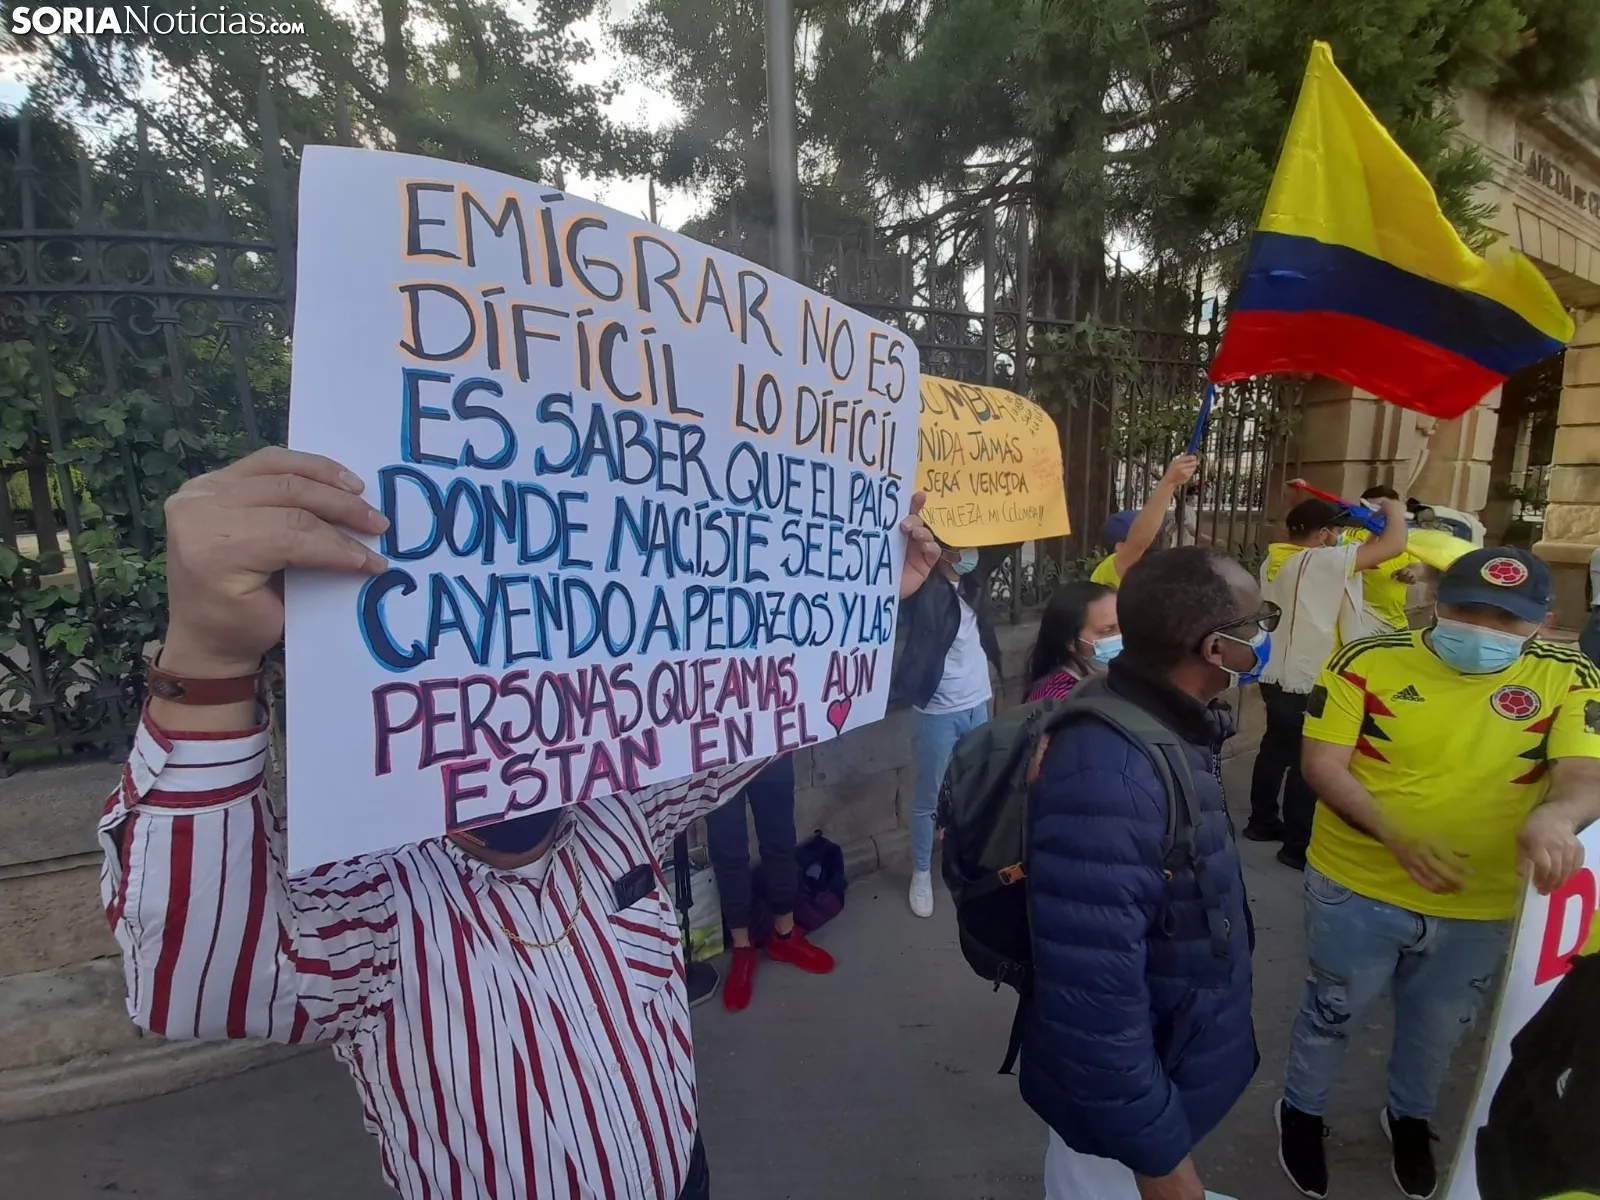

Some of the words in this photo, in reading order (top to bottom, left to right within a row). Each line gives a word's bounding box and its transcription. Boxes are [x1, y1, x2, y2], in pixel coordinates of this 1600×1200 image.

[736, 363, 781, 435] LO
[802, 299, 854, 381] NO
[869, 331, 905, 403] ES
[401, 367, 517, 470] ES
[535, 391, 723, 502] SABER
[726, 441, 804, 518] QUE
[811, 460, 845, 523] EL
[848, 471, 900, 531] PAÍS
[917, 421, 965, 466] NIDA
[967, 431, 1023, 464] JAMÁS
[923, 469, 960, 498] SERÁ
[969, 471, 1029, 496] VENCIDA
[379, 465, 592, 570] DONDE
[780, 519, 824, 577] SE
[920, 502, 983, 527] ORTALEZA
[357, 568, 636, 673] CAYENDO
[638, 585, 681, 655] A
[682, 585, 834, 652] PEDAZOS
[839, 592, 860, 648] Y
[858, 594, 895, 646] LAS
[372, 661, 642, 776] PERSONAS
[647, 656, 721, 724] QUE
[714, 653, 799, 713] AMAS
[821, 647, 878, 702] AÚN
[442, 726, 662, 834] ESTAN
[691, 711, 754, 774] EN
[775, 702, 818, 754] EL
